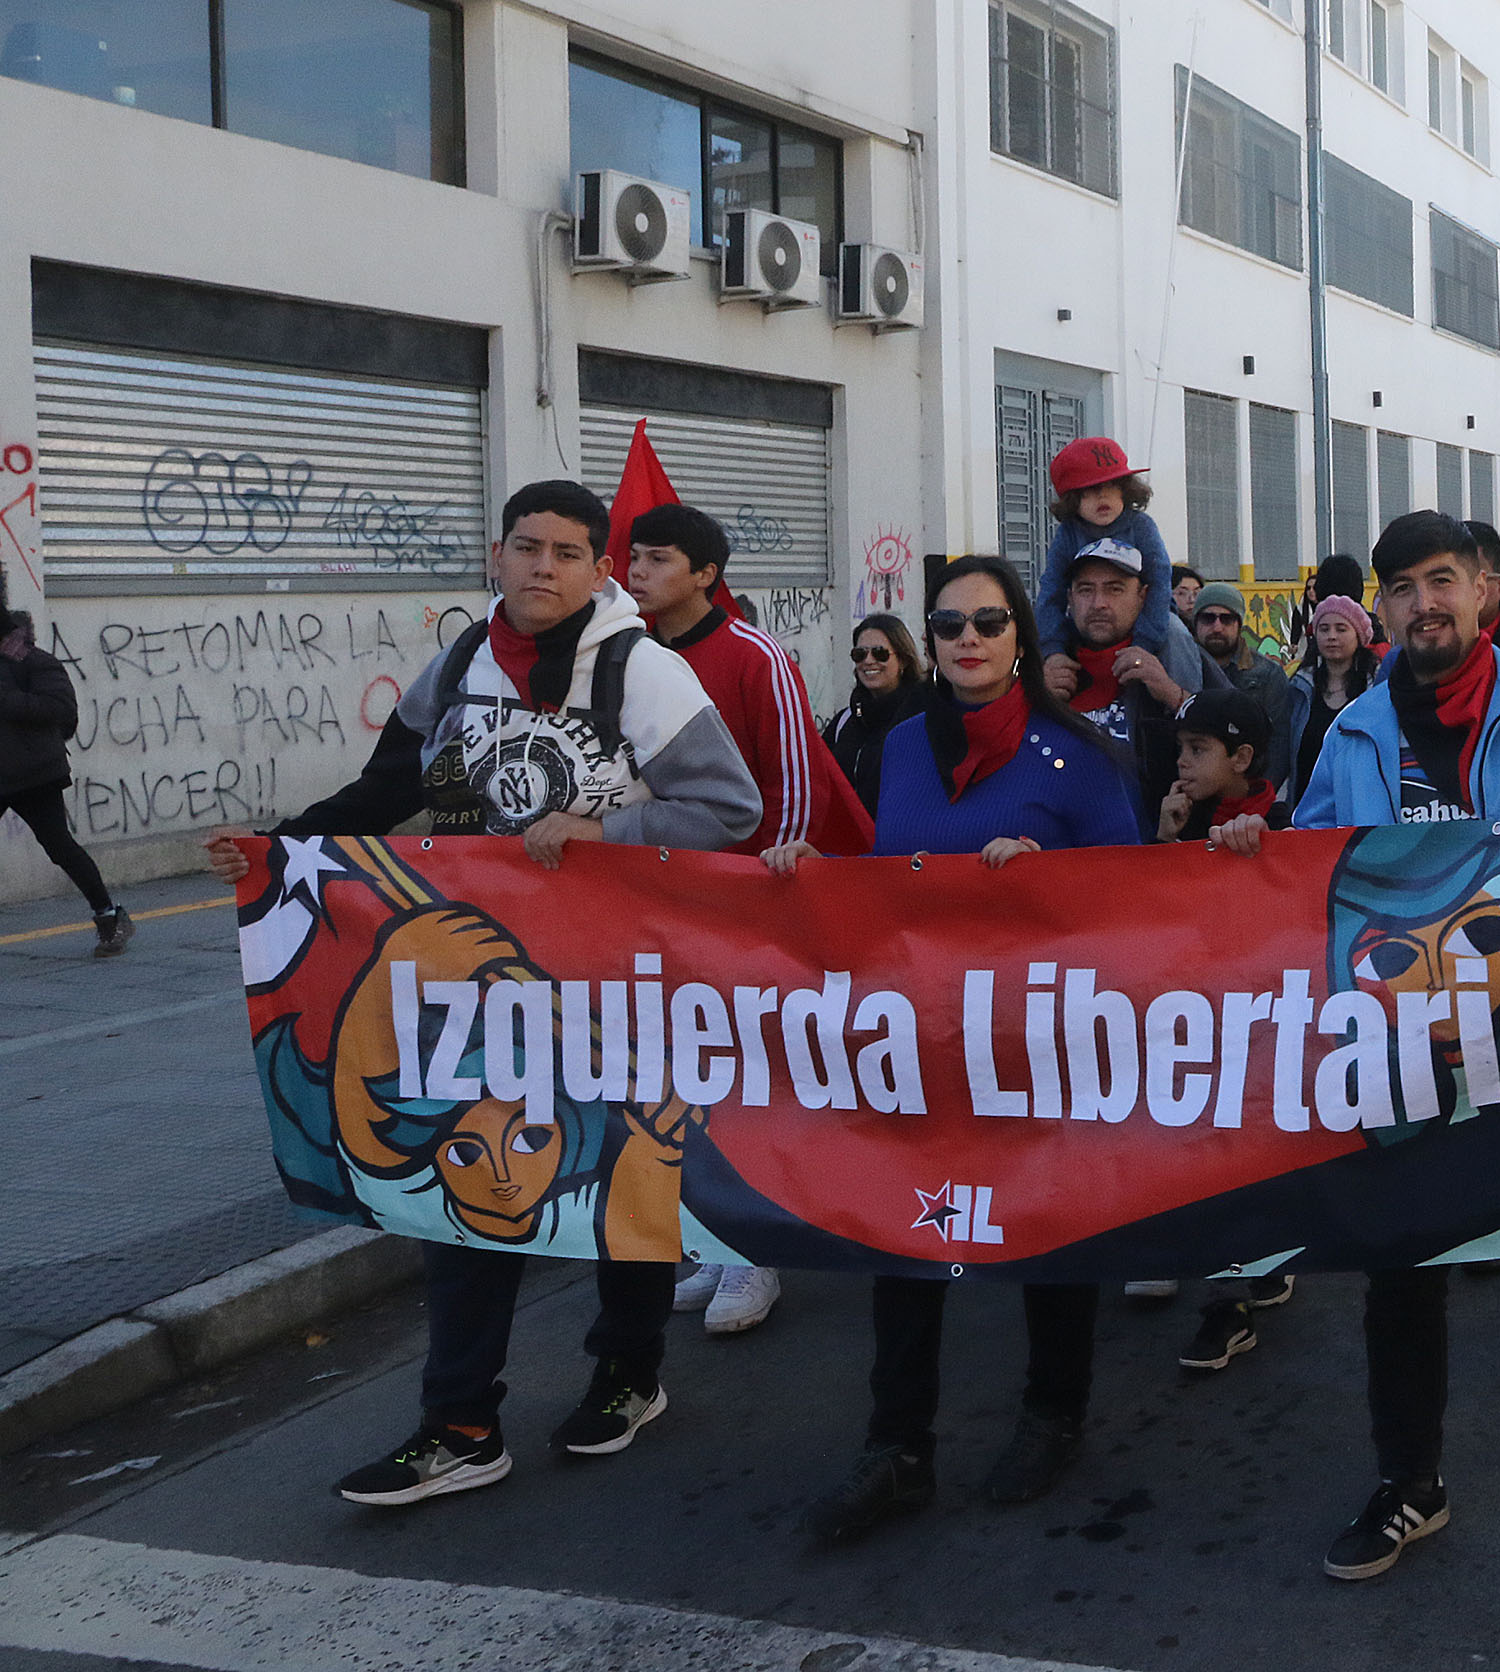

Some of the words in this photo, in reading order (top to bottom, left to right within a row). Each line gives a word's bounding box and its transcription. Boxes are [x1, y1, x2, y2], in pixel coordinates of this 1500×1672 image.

[99, 609, 336, 681] RETOMAR
[347, 606, 405, 662] LA
[72, 684, 205, 753] UCHA
[232, 684, 346, 753] PARA
[390, 953, 928, 1125] Izquierda
